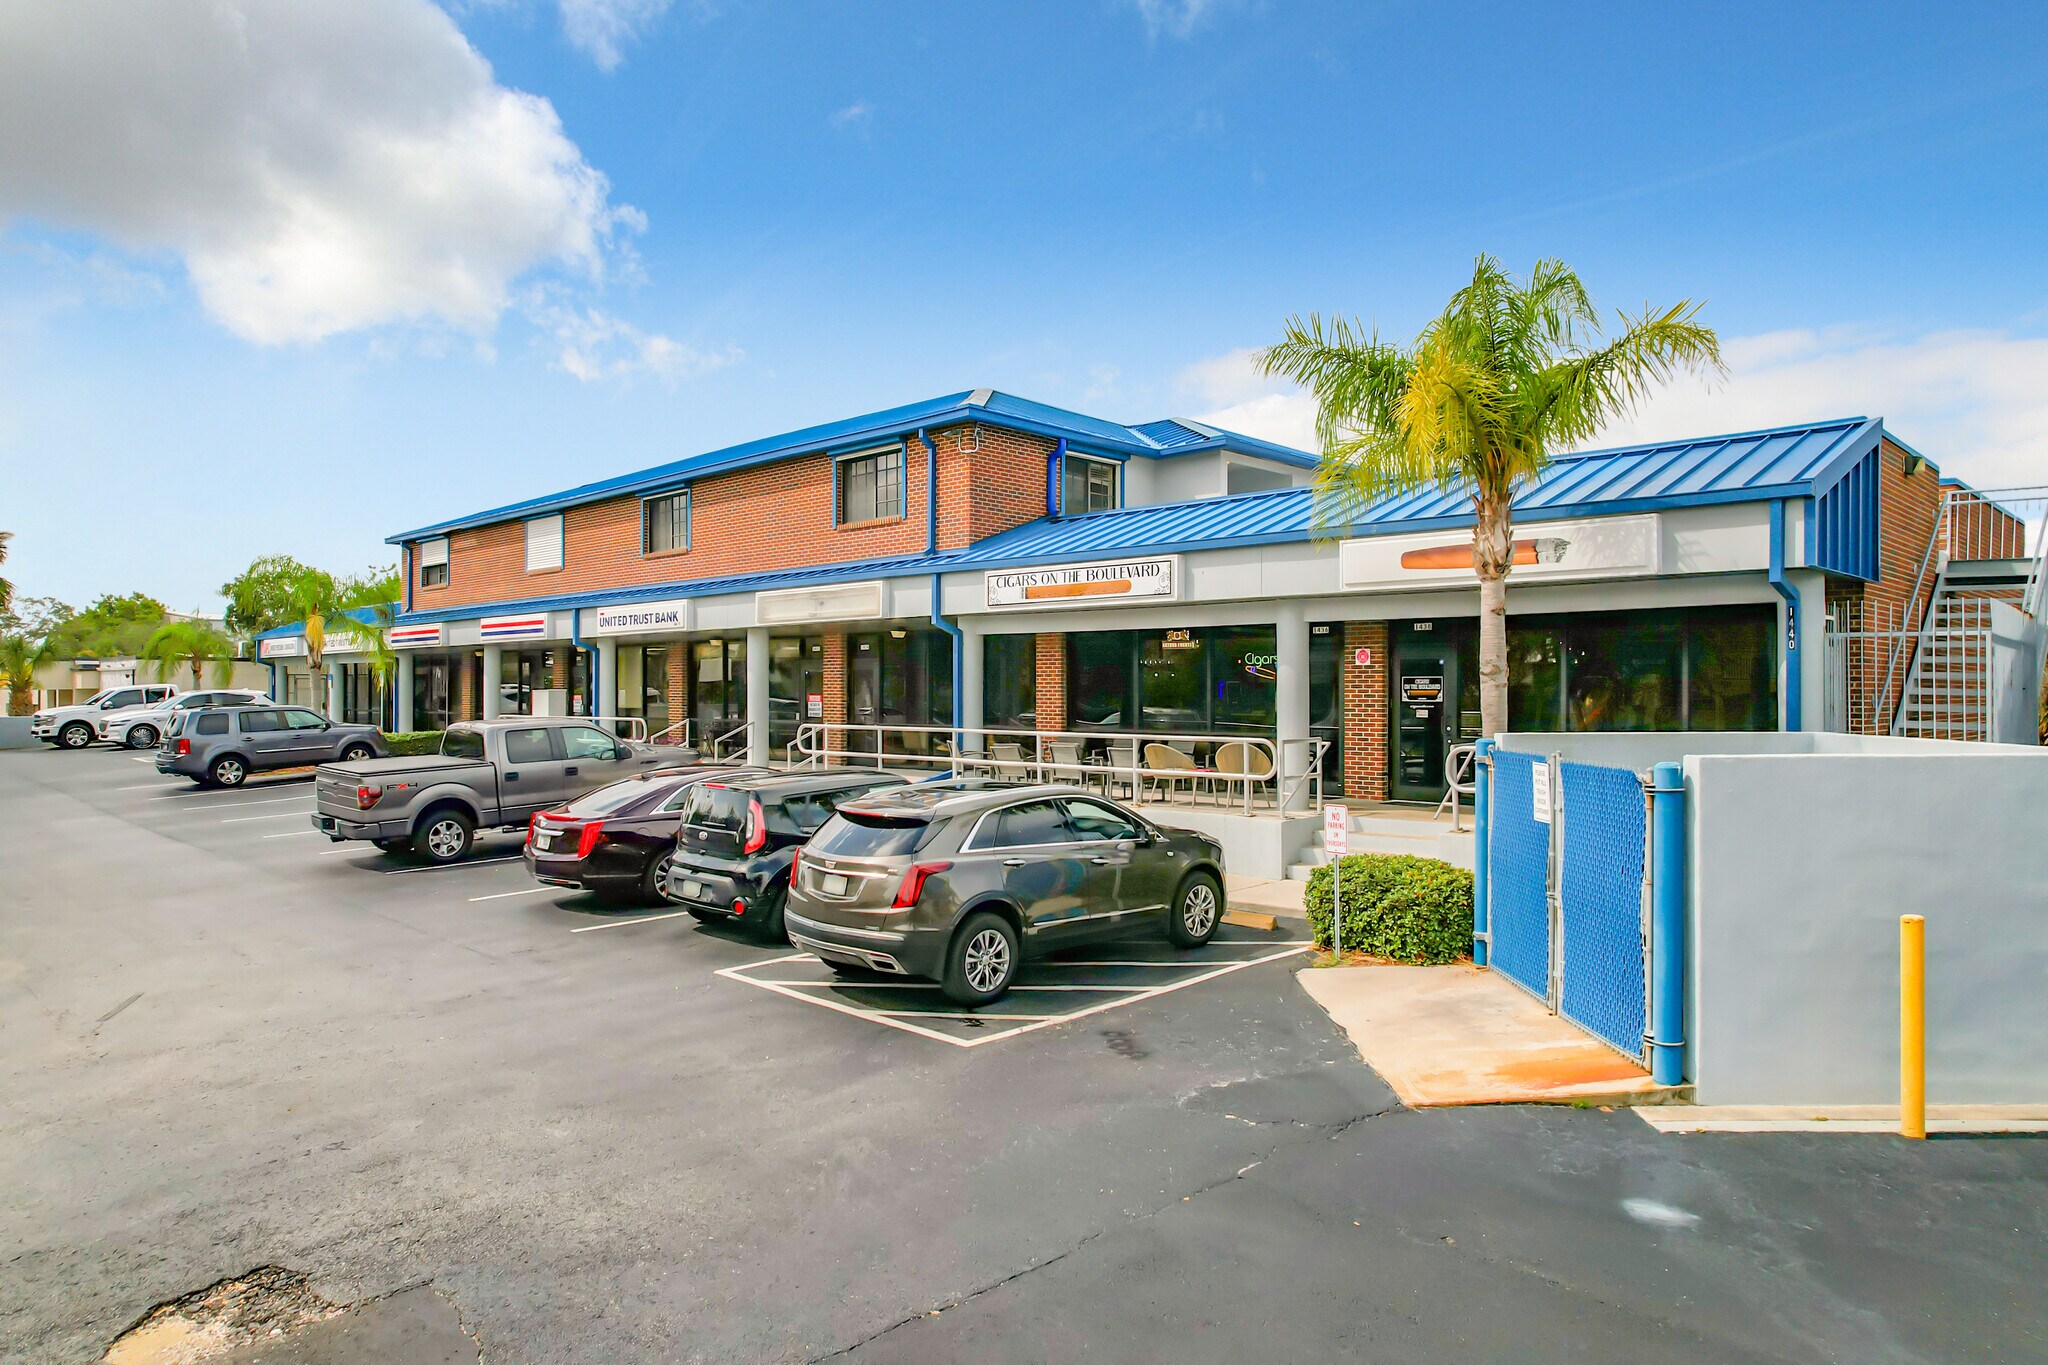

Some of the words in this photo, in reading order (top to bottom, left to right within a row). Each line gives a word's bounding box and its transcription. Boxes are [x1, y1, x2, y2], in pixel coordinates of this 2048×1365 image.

[996, 574, 1037, 588] CIGARS
[1041, 572, 1058, 585] ON
[1062, 569, 1082, 583] THE
[1086, 563, 1160, 581] BOULEVARD
[599, 615, 627, 628] UNITED
[629, 613, 654, 626] TRUST
[655, 610, 679, 624] BANK
[1244, 652, 1278, 667] Cigars
[386, 782, 418, 790] FX4
[1331, 812, 1340, 821] NO
[1327, 821, 1345, 830] PARKING
